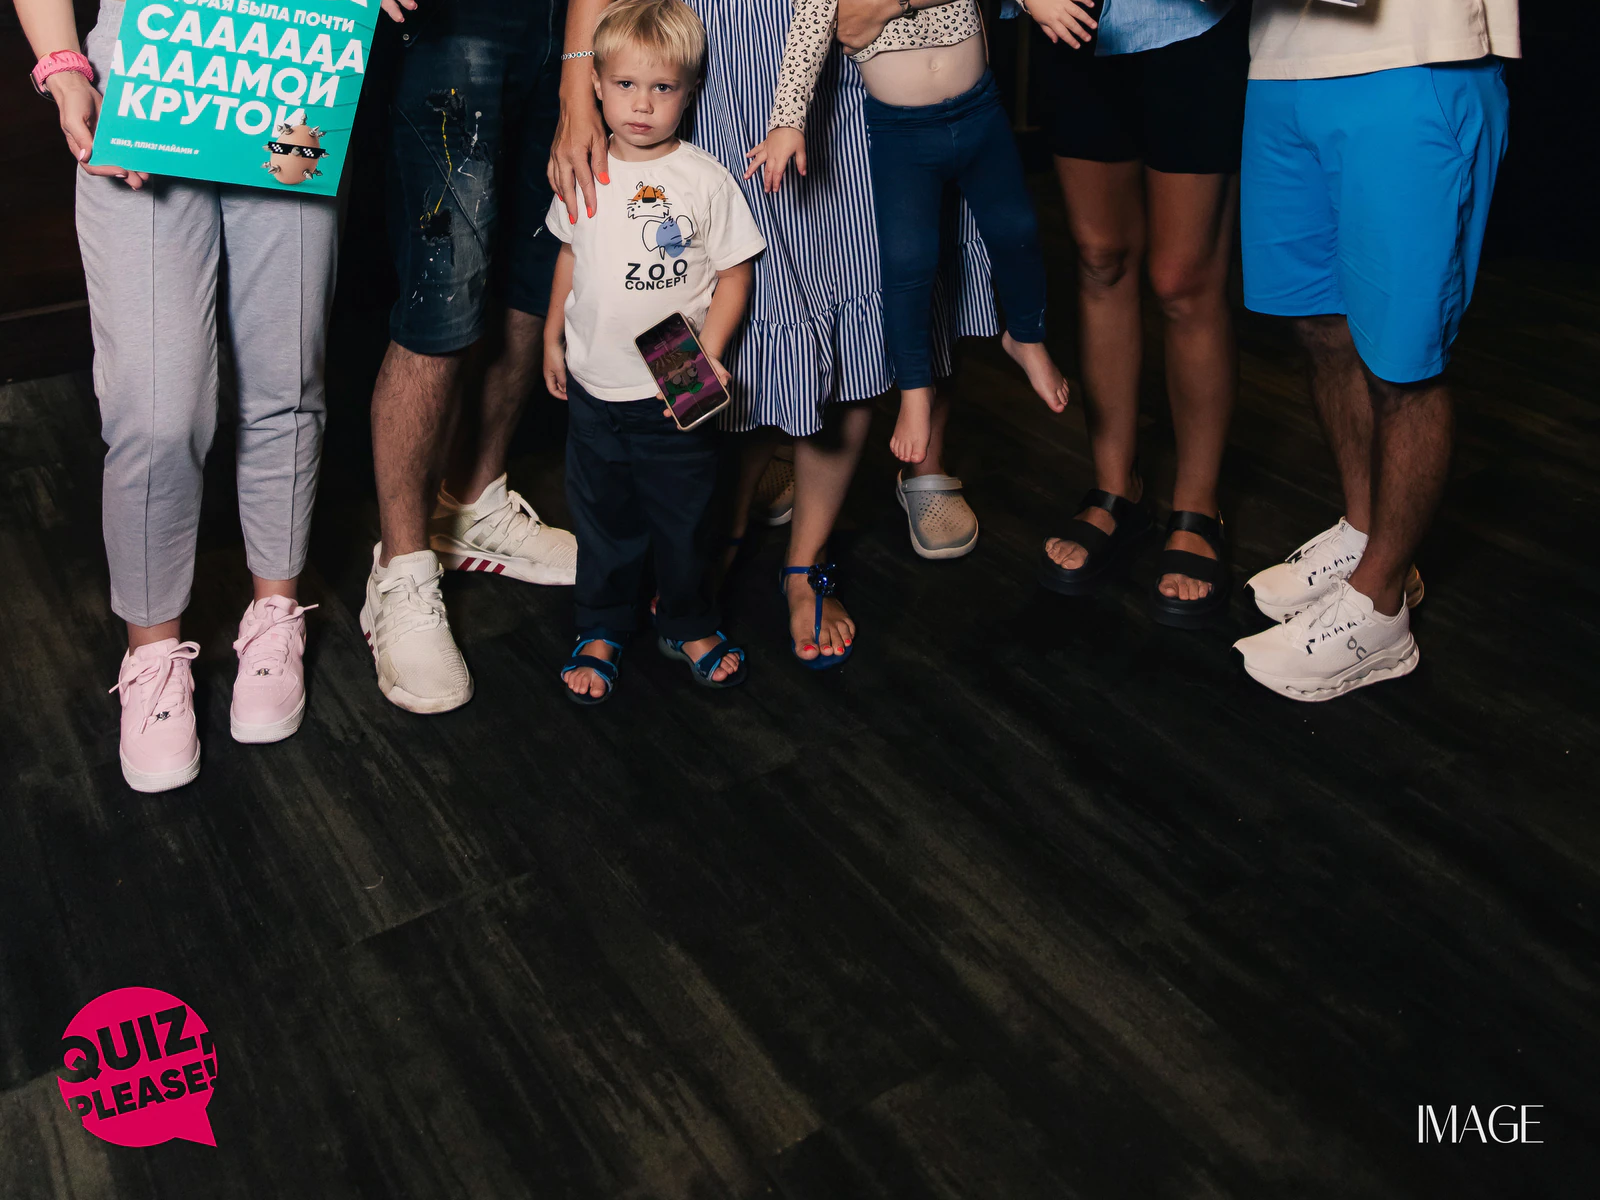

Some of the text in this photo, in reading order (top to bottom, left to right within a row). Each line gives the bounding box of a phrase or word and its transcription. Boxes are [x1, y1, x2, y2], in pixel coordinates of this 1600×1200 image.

[236, 0, 290, 22] БЫЛА
[292, 9, 355, 33] ПОЧТИ
[110, 137, 133, 148] КВИЗ,
[134, 141, 158, 151] ПЛИЗ!
[158, 143, 193, 154] МАЙАМИ
[625, 258, 688, 281] ZOO
[625, 274, 688, 291] CONCEPT
